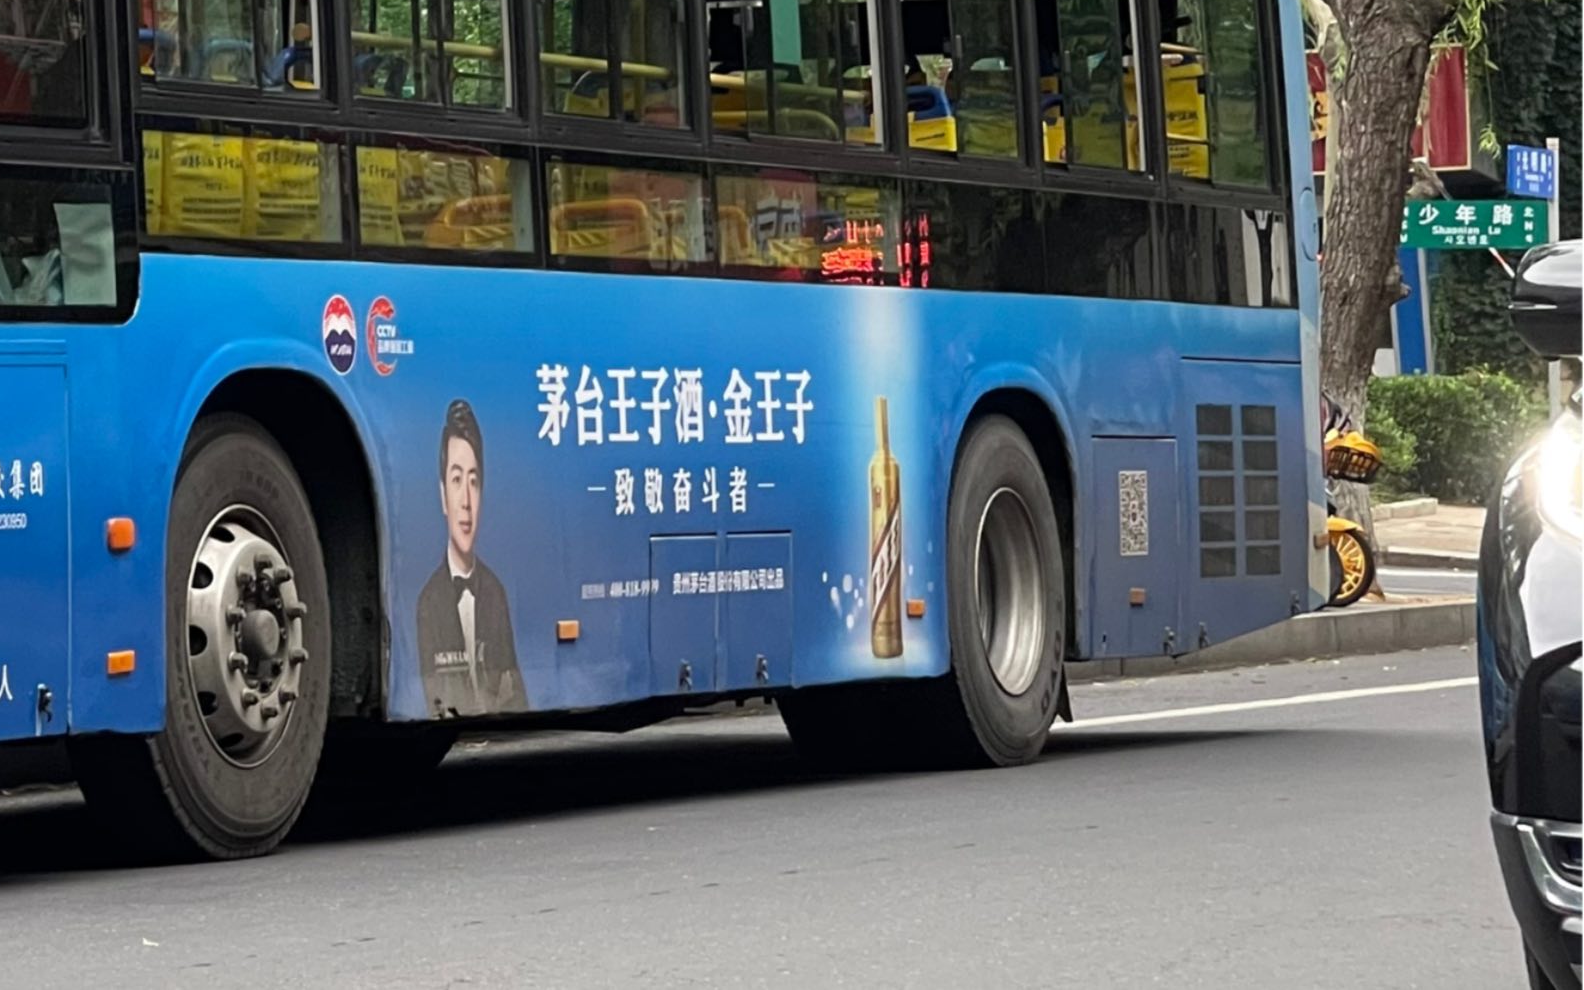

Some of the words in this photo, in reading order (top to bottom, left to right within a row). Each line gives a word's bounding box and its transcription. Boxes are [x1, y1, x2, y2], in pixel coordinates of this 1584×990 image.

[1419, 204, 1513, 225] 少年路
[614, 466, 748, 515] 致敬奋斗者
